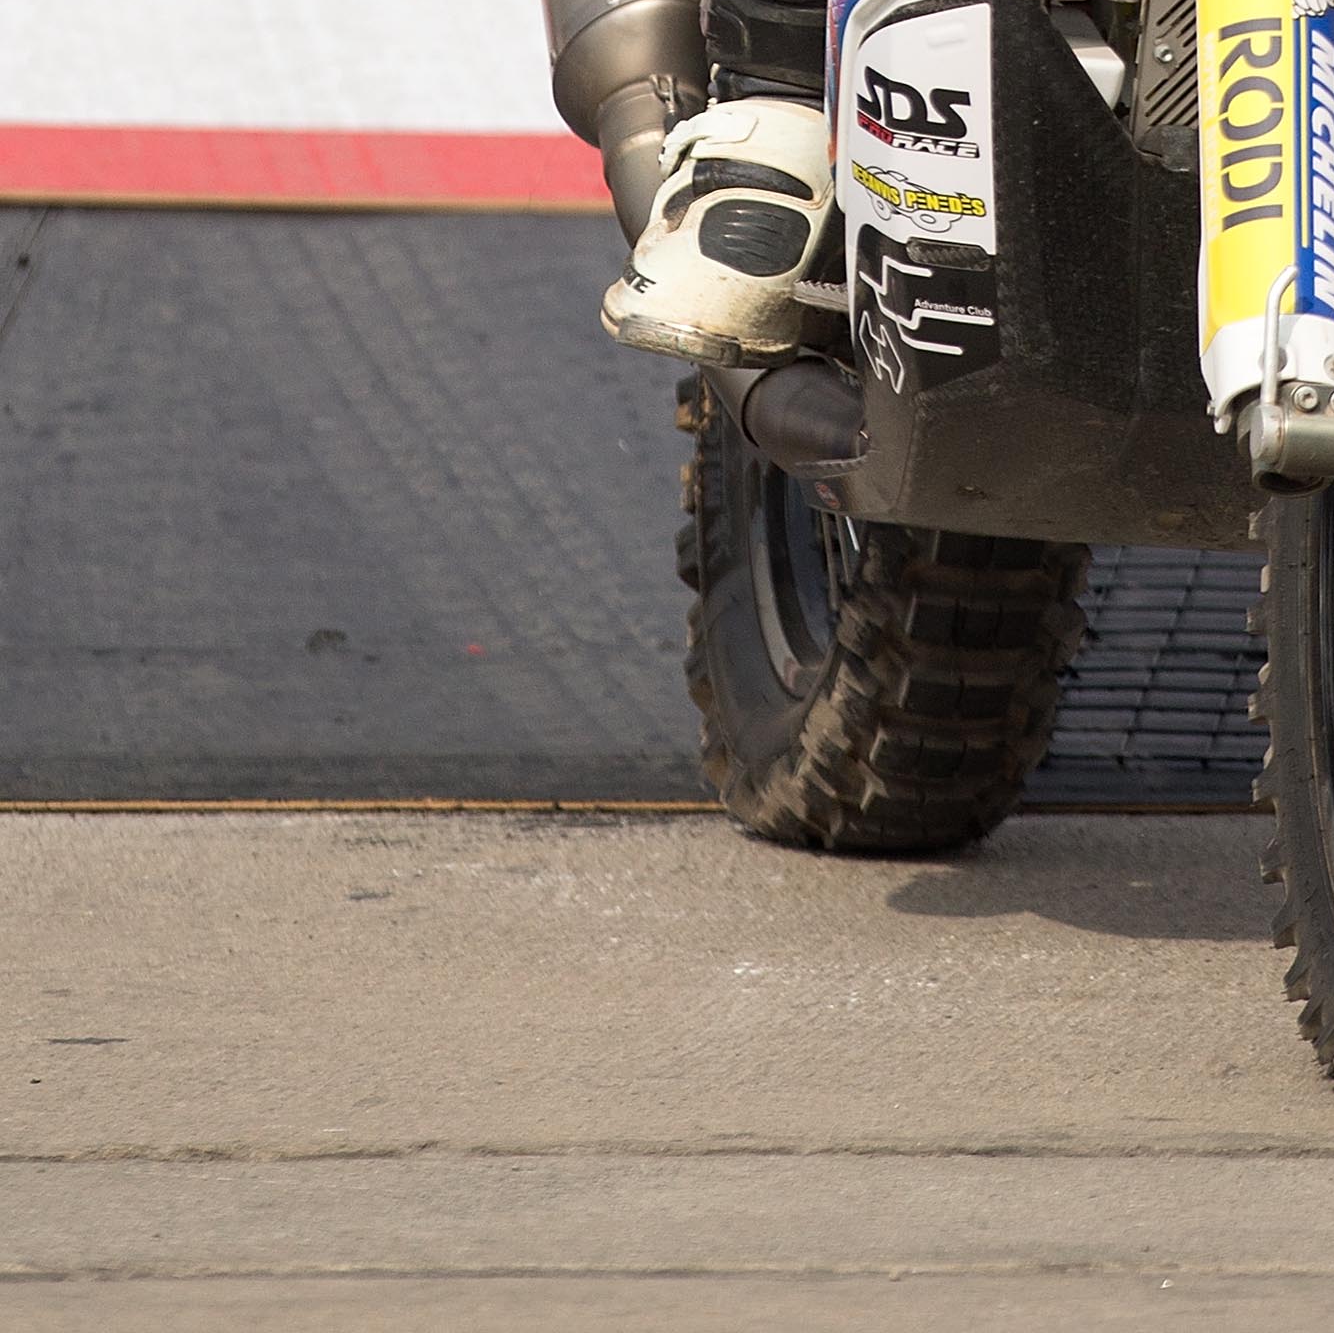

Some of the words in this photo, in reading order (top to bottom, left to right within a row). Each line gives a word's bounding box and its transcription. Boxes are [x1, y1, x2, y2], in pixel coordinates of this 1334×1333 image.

[856, 65, 972, 140] SDS
[1219, 16, 1285, 233] RODI
[966, 305, 993, 317] Club
